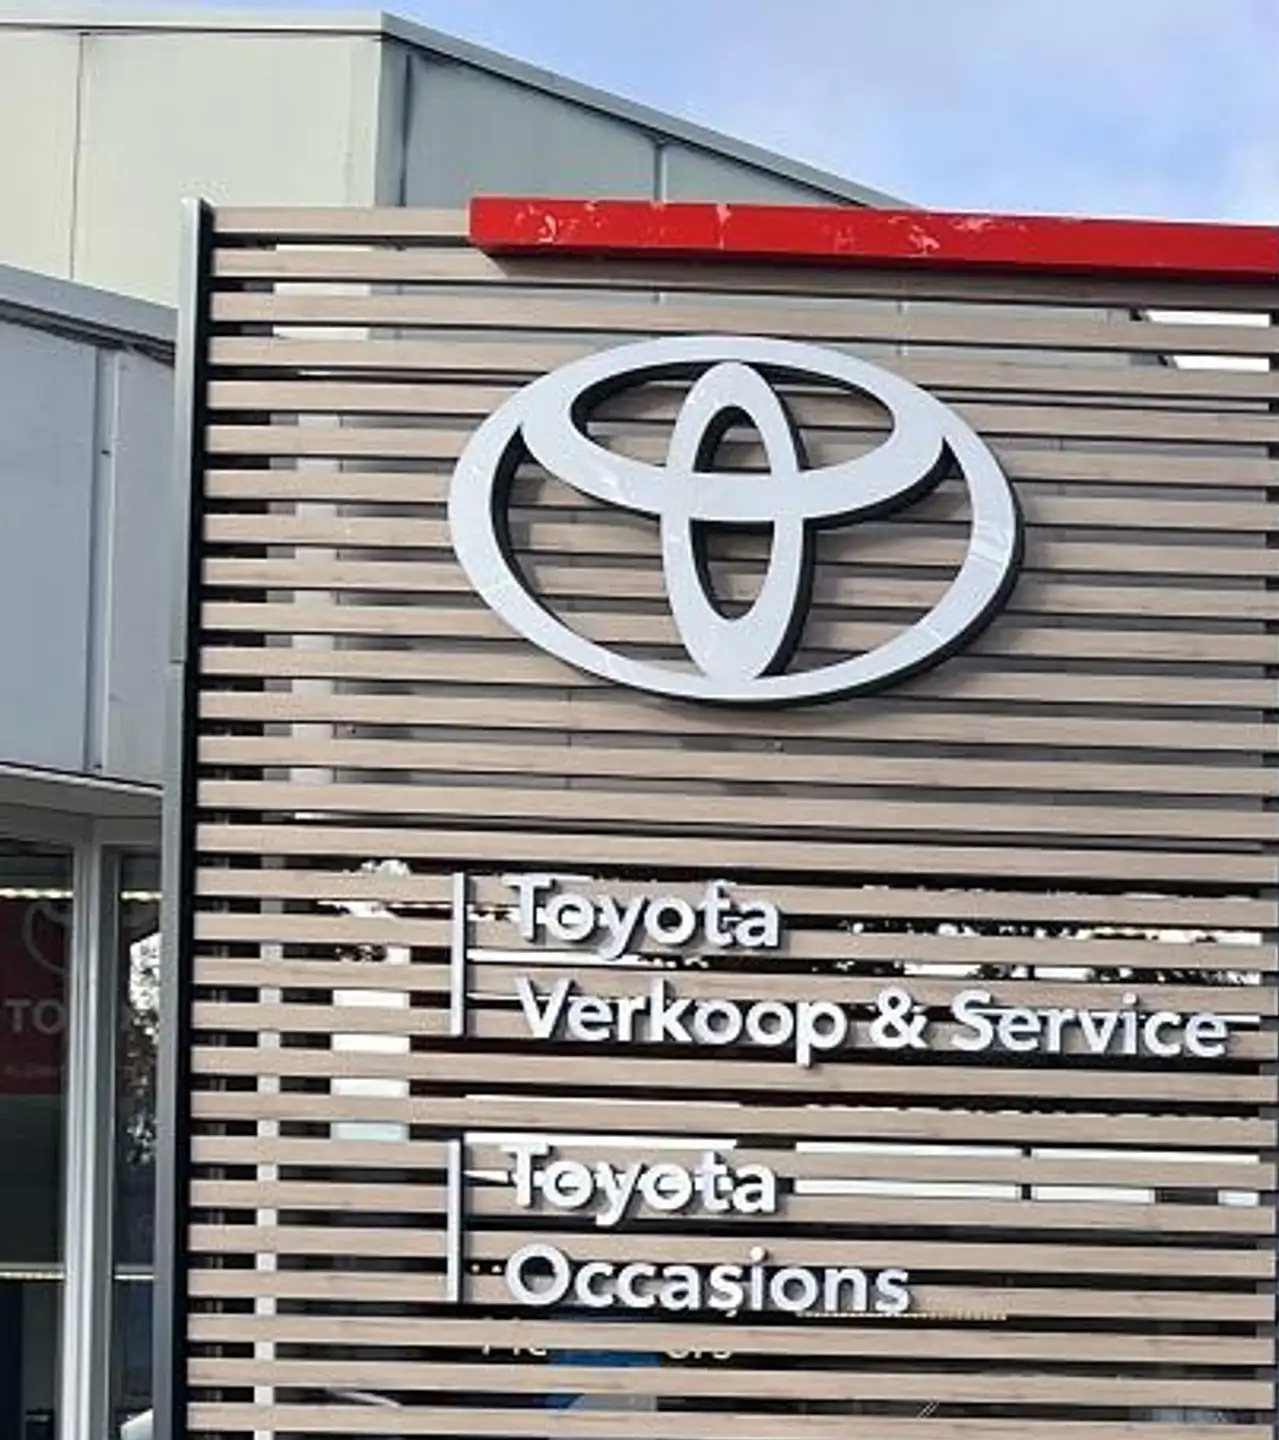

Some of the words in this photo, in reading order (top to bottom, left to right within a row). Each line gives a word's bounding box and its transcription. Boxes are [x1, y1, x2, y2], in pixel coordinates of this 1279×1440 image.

[503, 872, 781, 959] Toyota
[513, 976, 848, 1067] Verkoop
[867, 985, 928, 1050] &
[950, 989, 1229, 1058] Service
[501, 1143, 778, 1226] Toyota
[505, 1242, 912, 1312] Occasions
